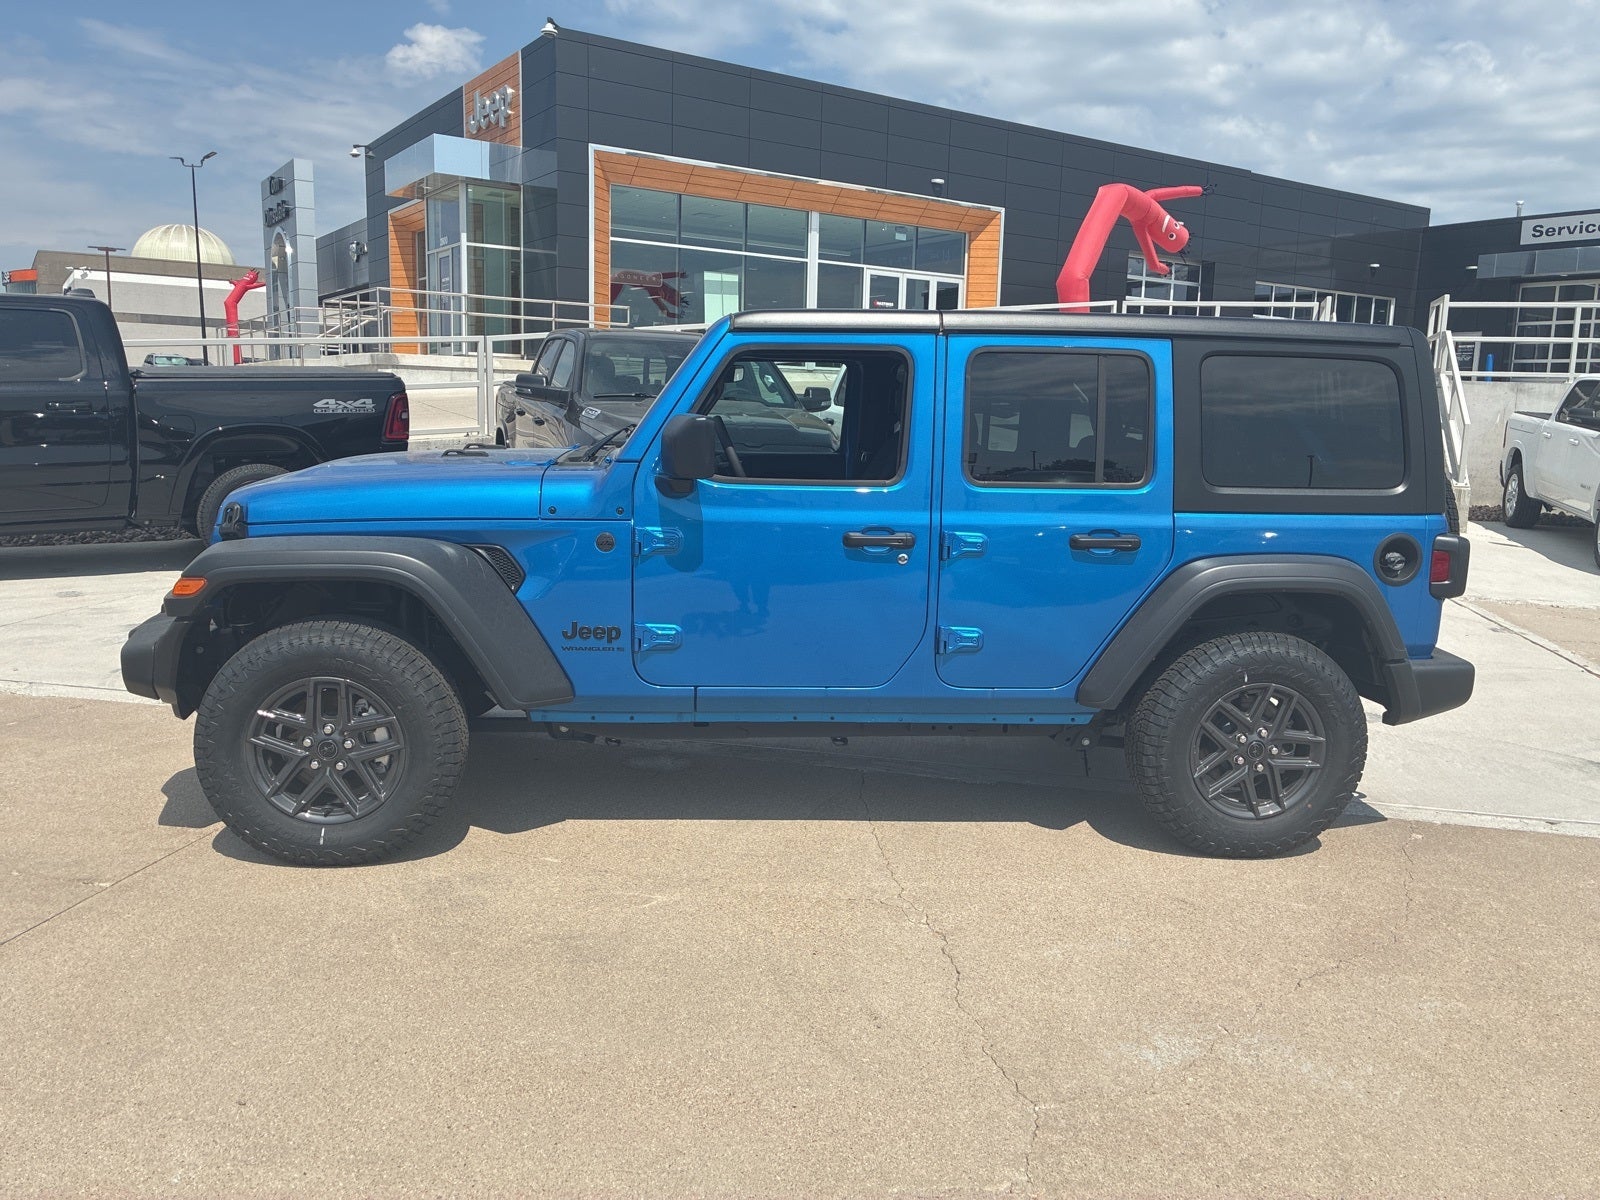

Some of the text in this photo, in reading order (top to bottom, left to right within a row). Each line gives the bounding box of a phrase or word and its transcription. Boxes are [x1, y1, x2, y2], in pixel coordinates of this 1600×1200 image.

[469, 84, 515, 134] Jeep
[1531, 220, 1600, 238] Servic
[561, 620, 622, 644] Jeep
